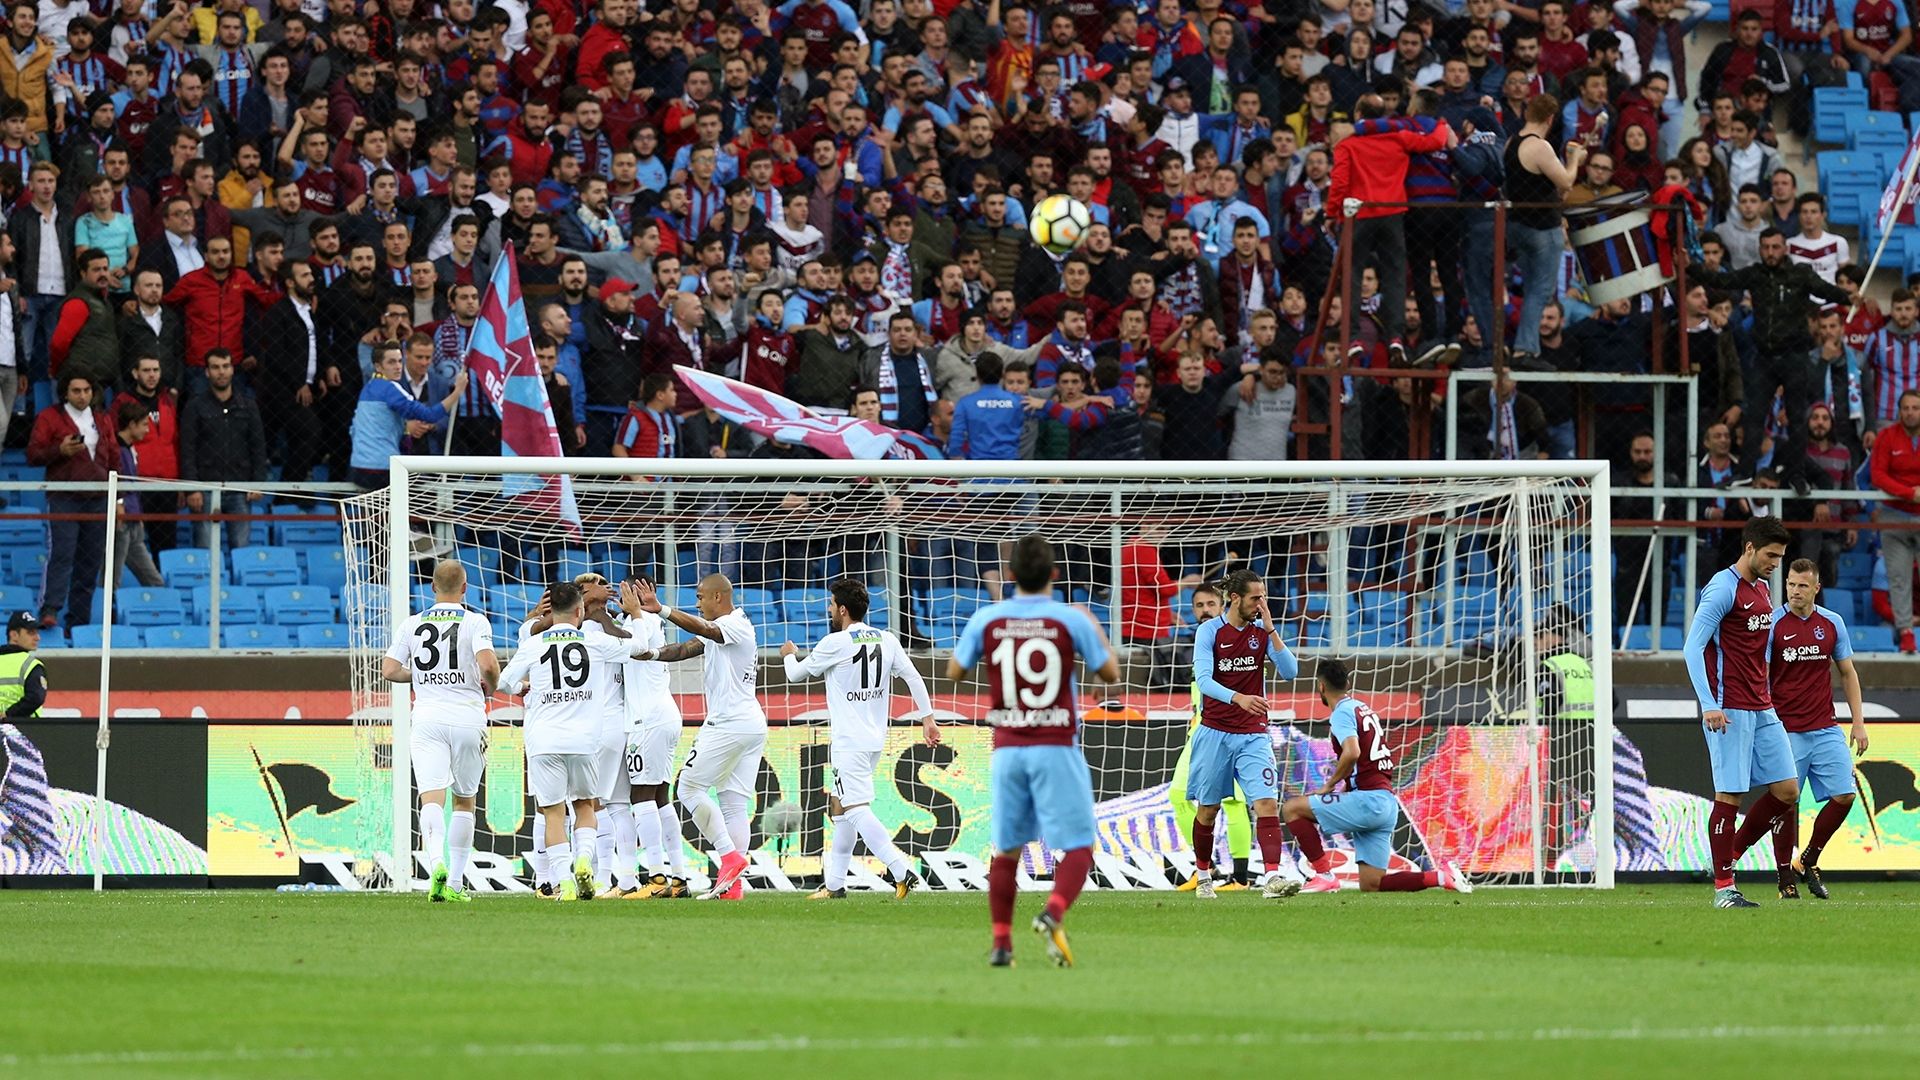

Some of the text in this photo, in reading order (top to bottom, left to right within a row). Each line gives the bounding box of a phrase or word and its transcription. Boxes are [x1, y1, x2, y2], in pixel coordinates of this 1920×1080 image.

[414, 622, 460, 671] 31
[1797, 646, 1820, 655] QNB
[540, 642, 590, 690] 19
[852, 643, 883, 689] 11
[1233, 656, 1255, 666] QNB
[417, 672, 466, 685] LARSSON
[992, 637, 1062, 710] 19
[564, 690, 593, 702] BAYRAM
[626, 754, 643, 772] 20
[685, 749, 698, 768] 2
[1262, 767, 1274, 787] 9
